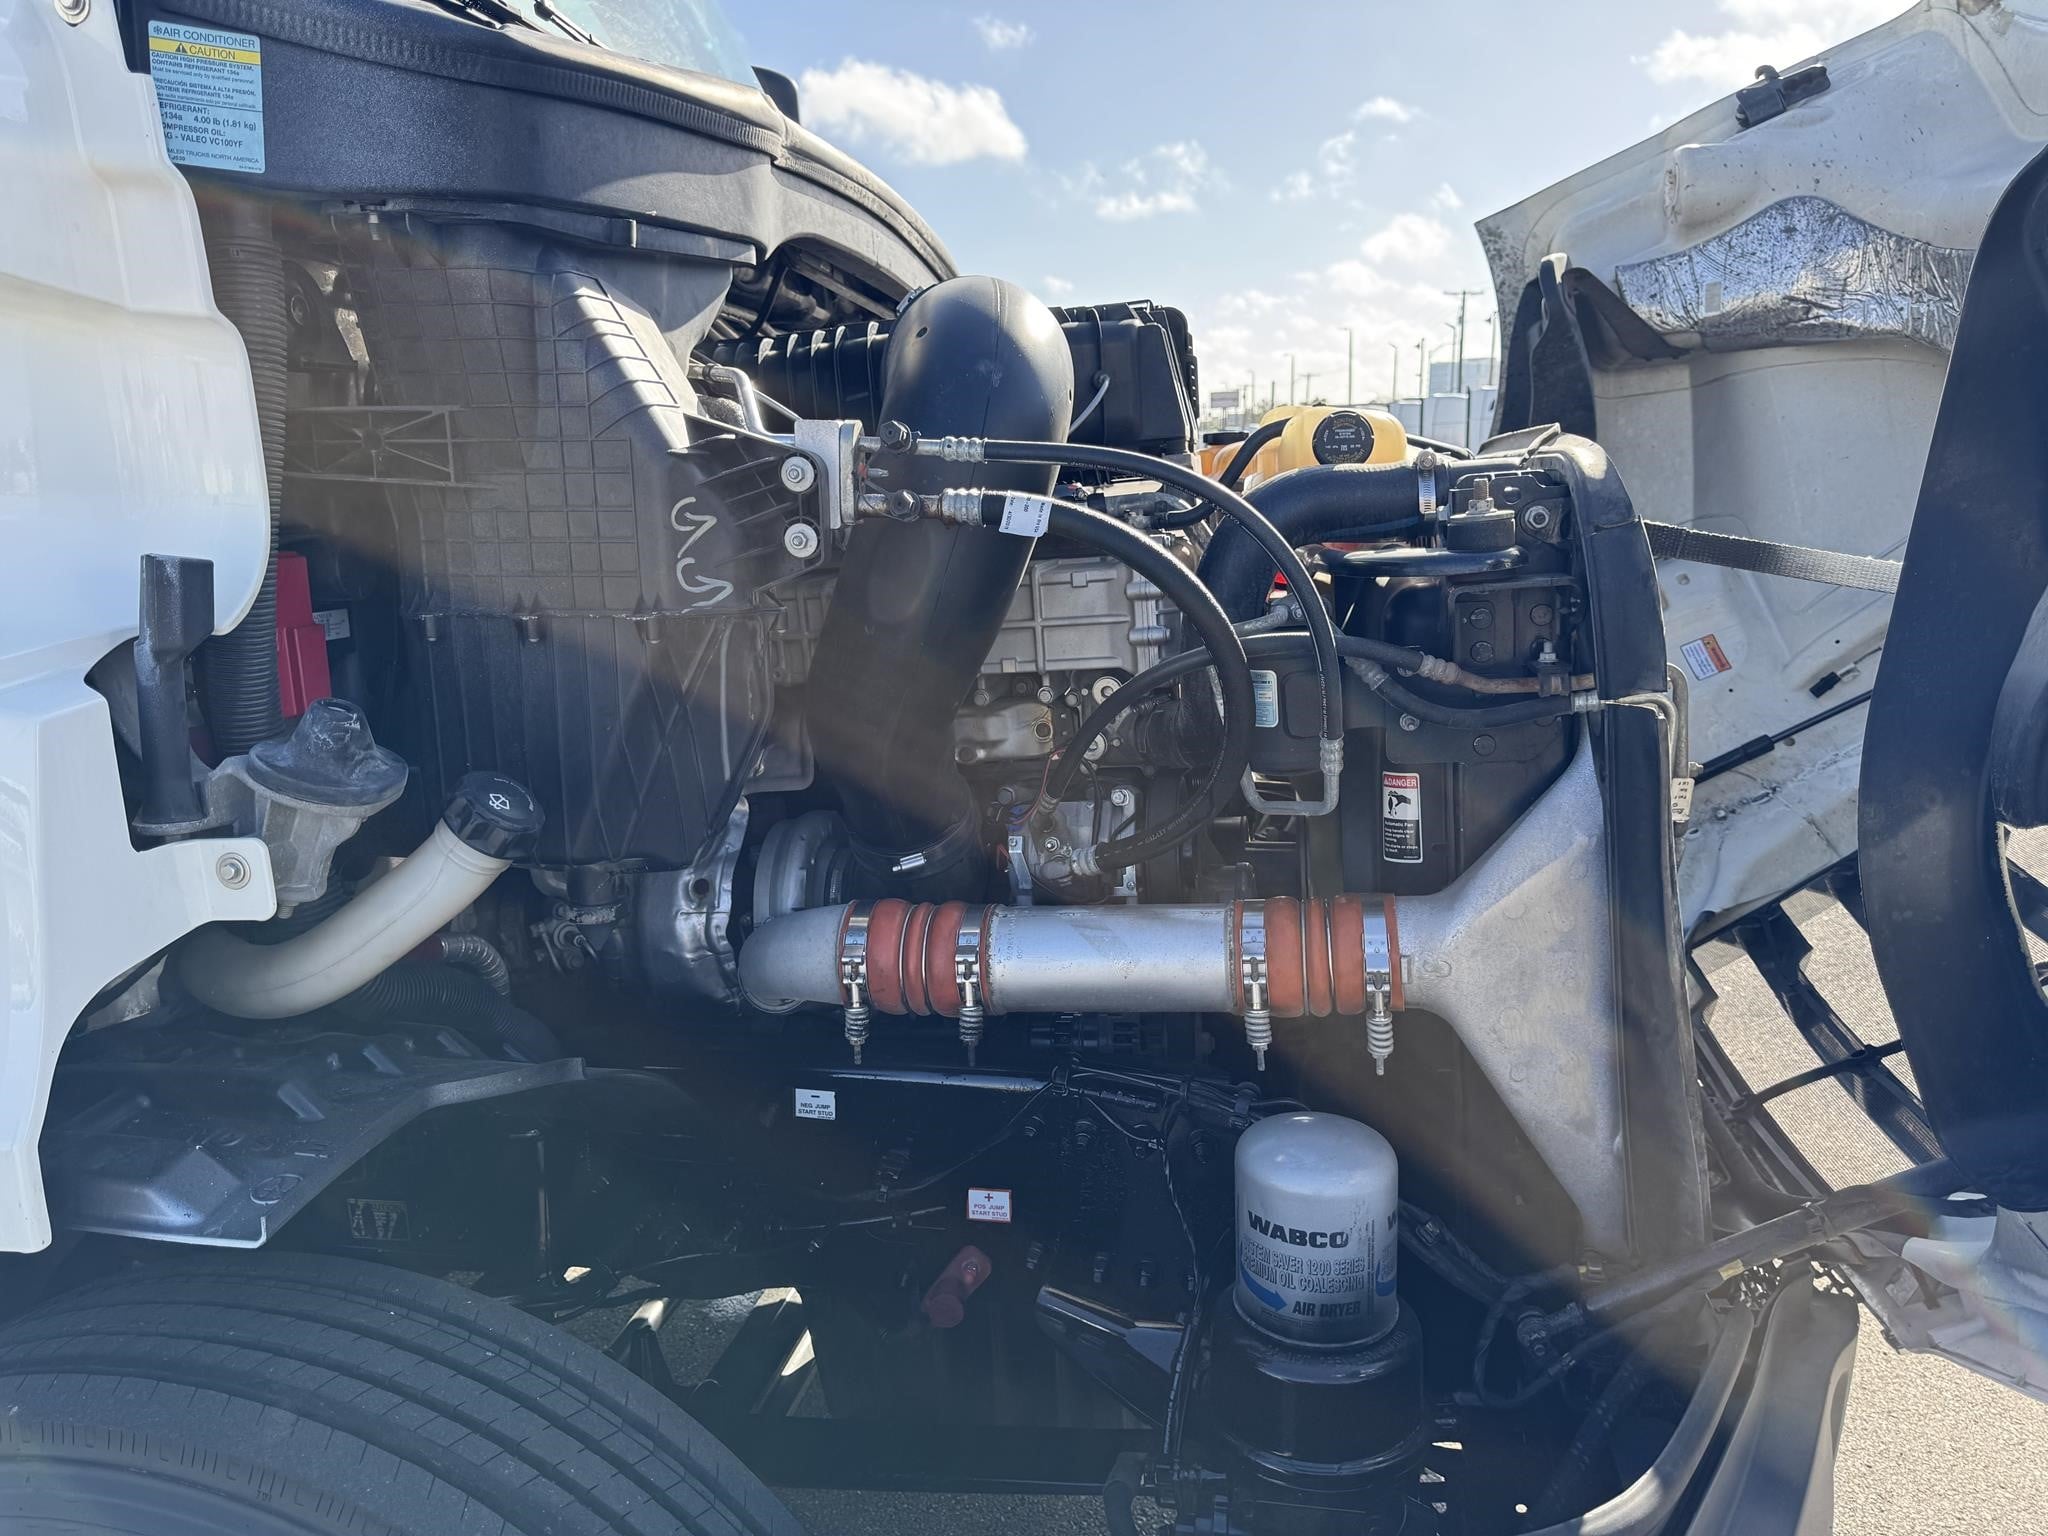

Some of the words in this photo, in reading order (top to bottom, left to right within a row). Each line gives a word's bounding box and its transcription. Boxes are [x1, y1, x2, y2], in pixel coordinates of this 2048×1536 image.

[162, 28, 181, 38] AIR
[183, 30, 256, 49] CONDITIONER
[151, 52, 178, 60] CAUTION
[196, 58, 227, 67] PRESSURE
[189, 45, 236, 60] CAUTION
[152, 58, 182, 67] CONTAINS
[184, 62, 224, 73] REFRIGERANT
[159, 101, 209, 115] EFRIGERANT:
[161, 110, 182, 120] -134a
[193, 115, 211, 124] 4.00
[213, 117, 220, 125] lb
[222, 118, 241, 129] (1.81
[243, 121, 256, 131] kg)
[162, 121, 209, 134] OMPRESSOR
[211, 128, 225, 136] OIL:
[180, 133, 207, 144] VALEO
[209, 137, 243, 148] VC100YF
[186, 150, 209, 158] TRUCKS
[211, 153, 231, 161] NORTH
[1388, 777, 1417, 787] DANGER
[798, 1108, 816, 1116] START
[1248, 1210, 1349, 1248] WABCO
[1272, 1249, 1304, 1275] SAVER
[1306, 1258, 1332, 1277] 1200
[1333, 1256, 1366, 1277] SERIES
[1279, 1270, 1297, 1290] OIL
[1291, 1300, 1316, 1318] AIR
[1319, 1300, 1362, 1318] DRYER
